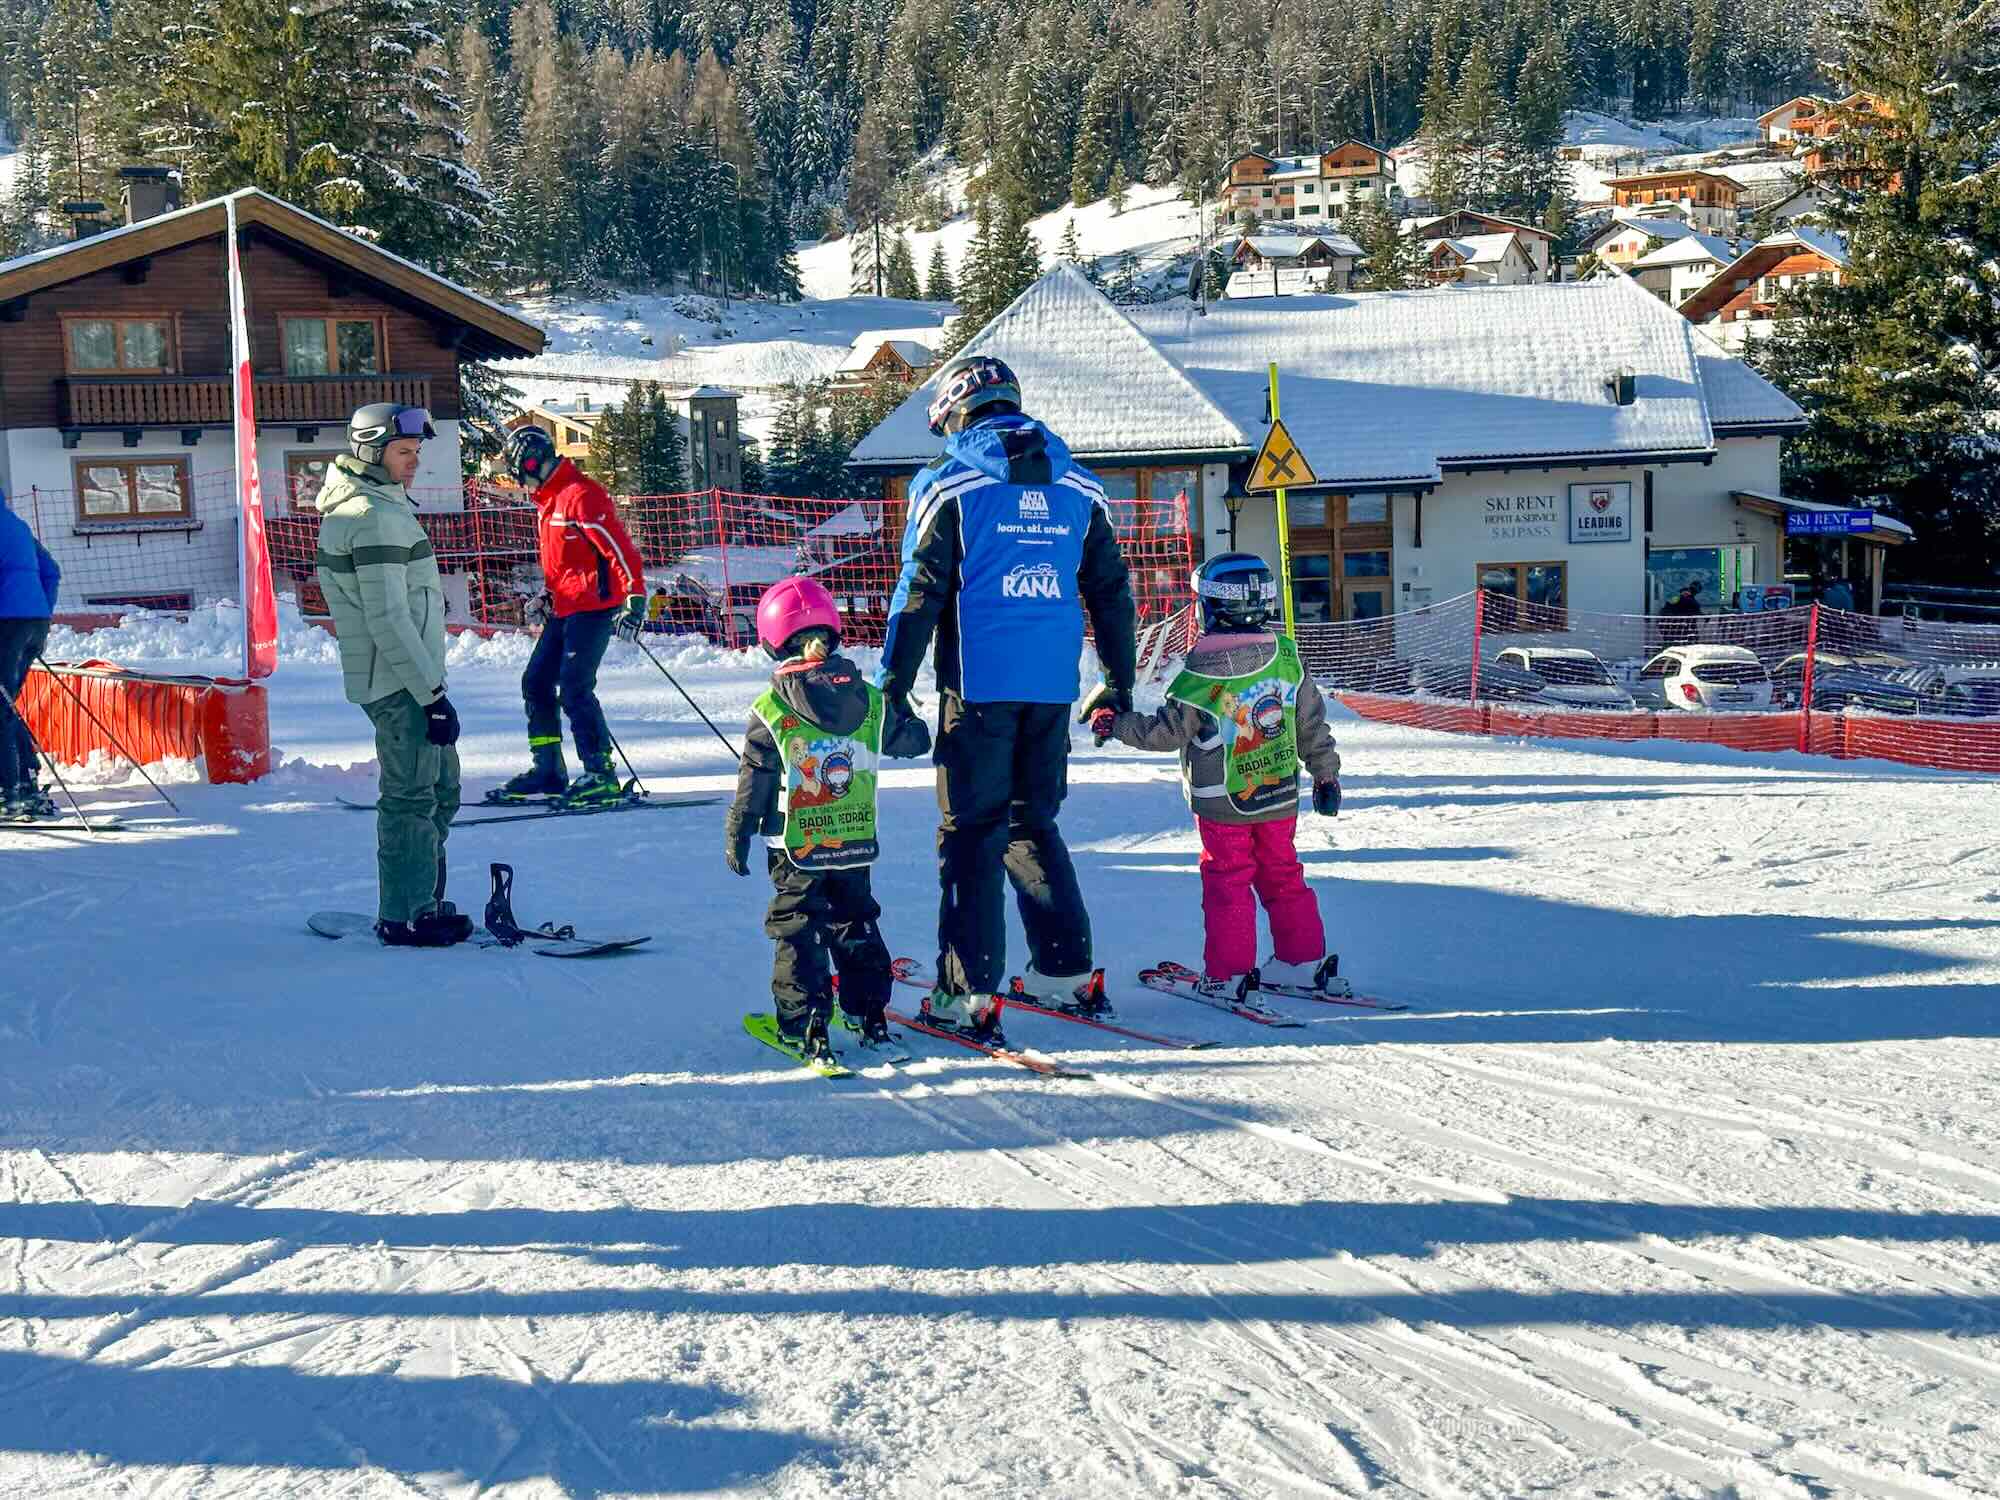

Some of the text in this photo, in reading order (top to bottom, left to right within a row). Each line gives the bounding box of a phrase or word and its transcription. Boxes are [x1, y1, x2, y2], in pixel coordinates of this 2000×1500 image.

[1486, 495, 1556, 511] SKI RENT
[1578, 516, 1622, 528] LEADING
[1789, 513, 1849, 525] SKI RENT
[1491, 526, 1552, 538] SKIPASS
[1003, 575, 1061, 598] RANA
[1236, 756, 1271, 775] BADIA
[799, 815, 833, 829] BADIA
